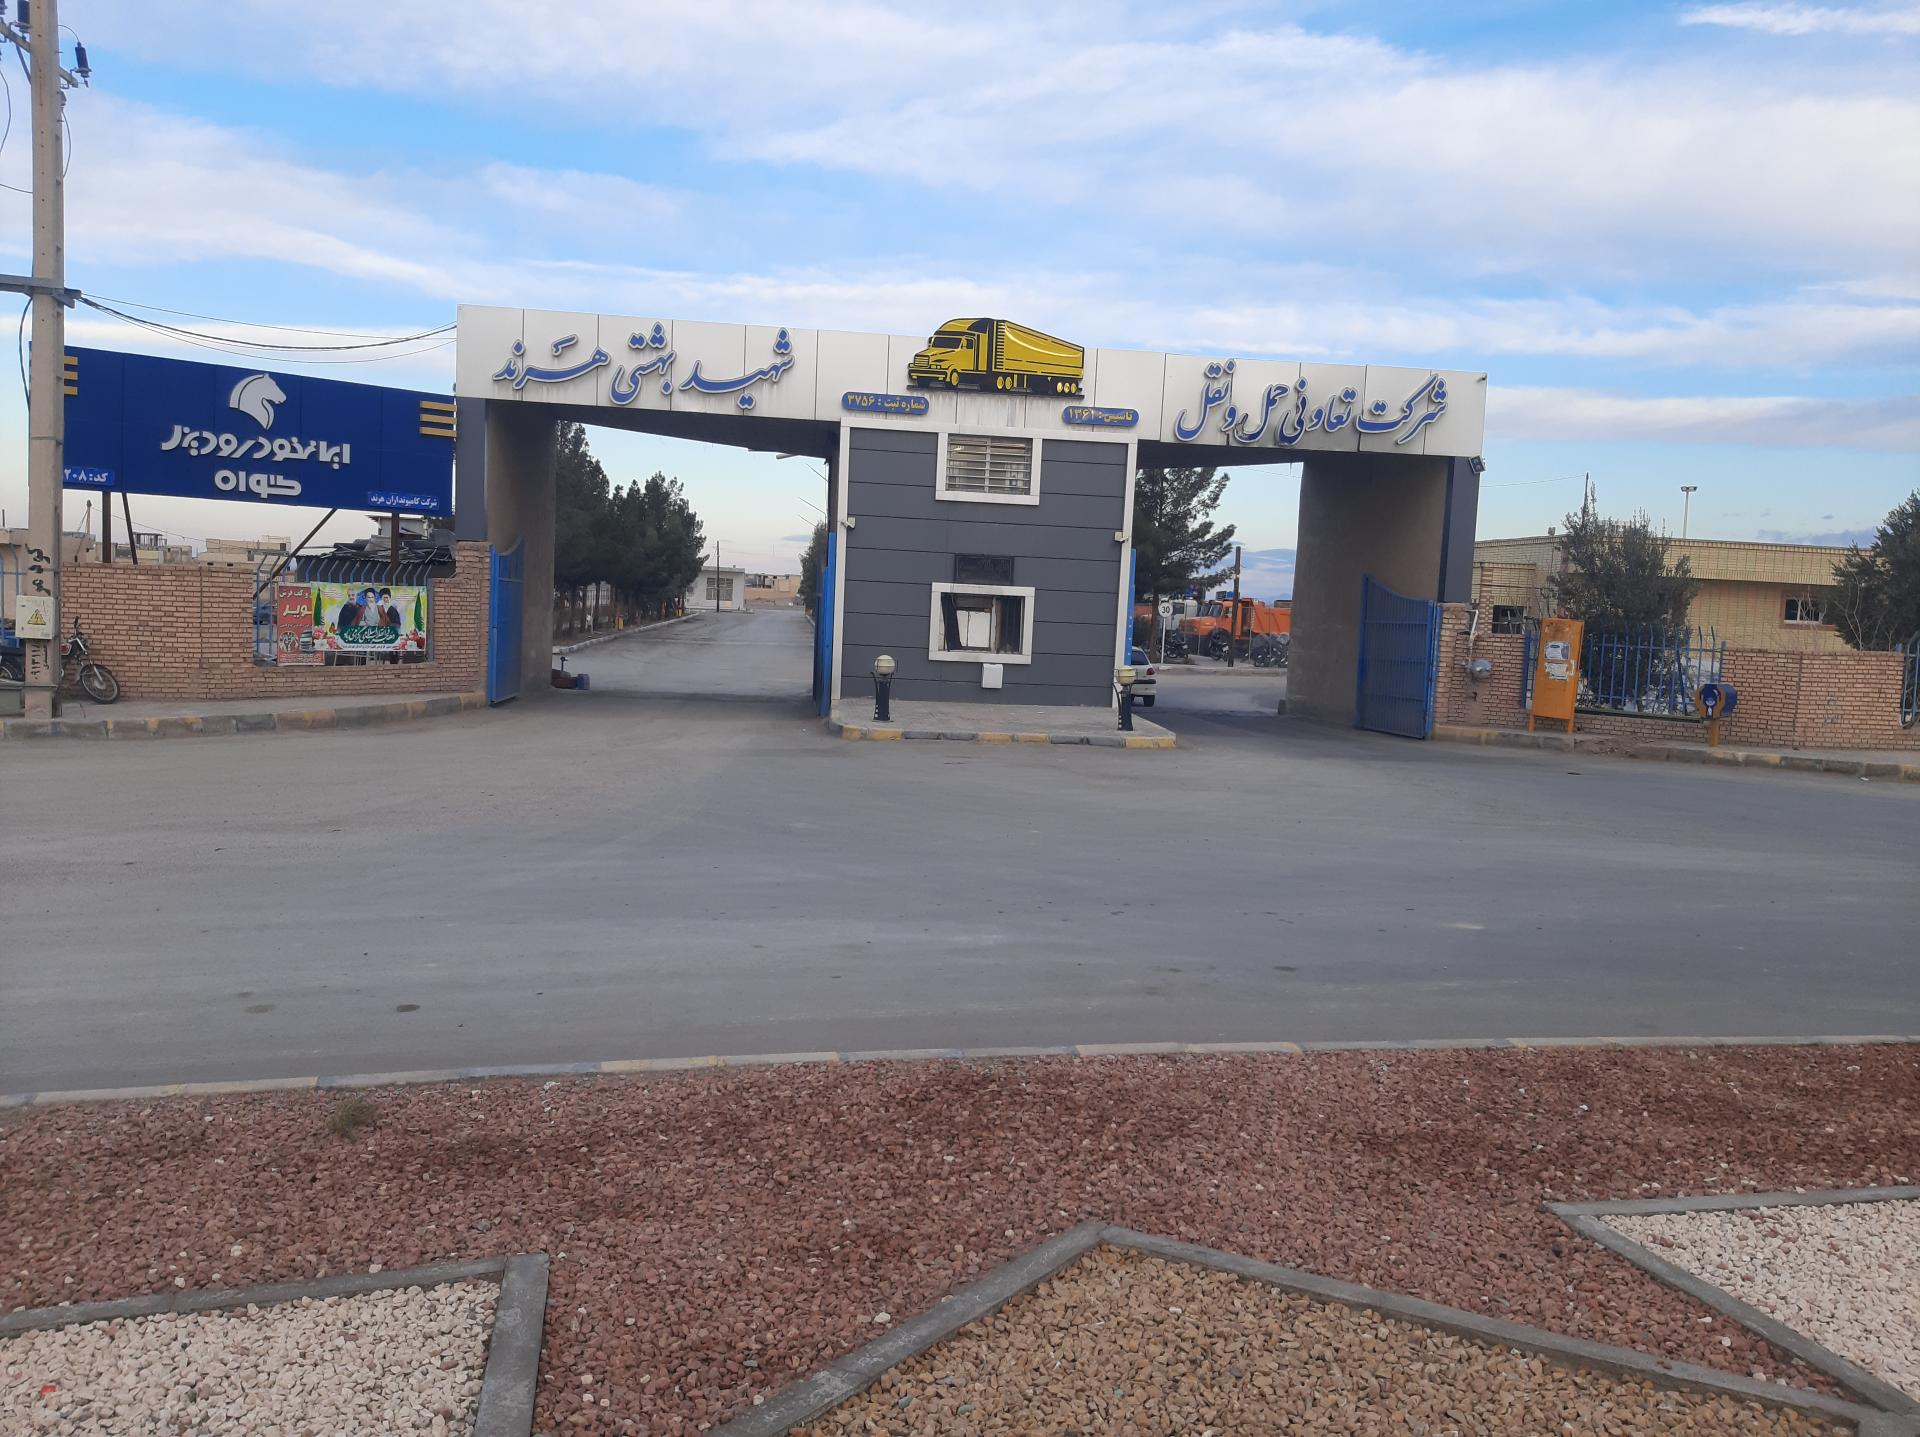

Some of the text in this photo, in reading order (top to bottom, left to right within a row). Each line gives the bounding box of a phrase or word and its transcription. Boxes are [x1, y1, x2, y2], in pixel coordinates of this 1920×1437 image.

[608, 320, 678, 406] بهشتی
[678, 326, 796, 409] شهید
[847, 394, 875, 407] ۳۷۵۶
[901, 398, 926, 412] شماره
[1174, 359, 1449, 447] شرکت تعاونی حمل و نقل
[370, 493, 385, 505] هرند
[420, 496, 438, 509] شرکت
[1161, 605, 1171, 614] 30
